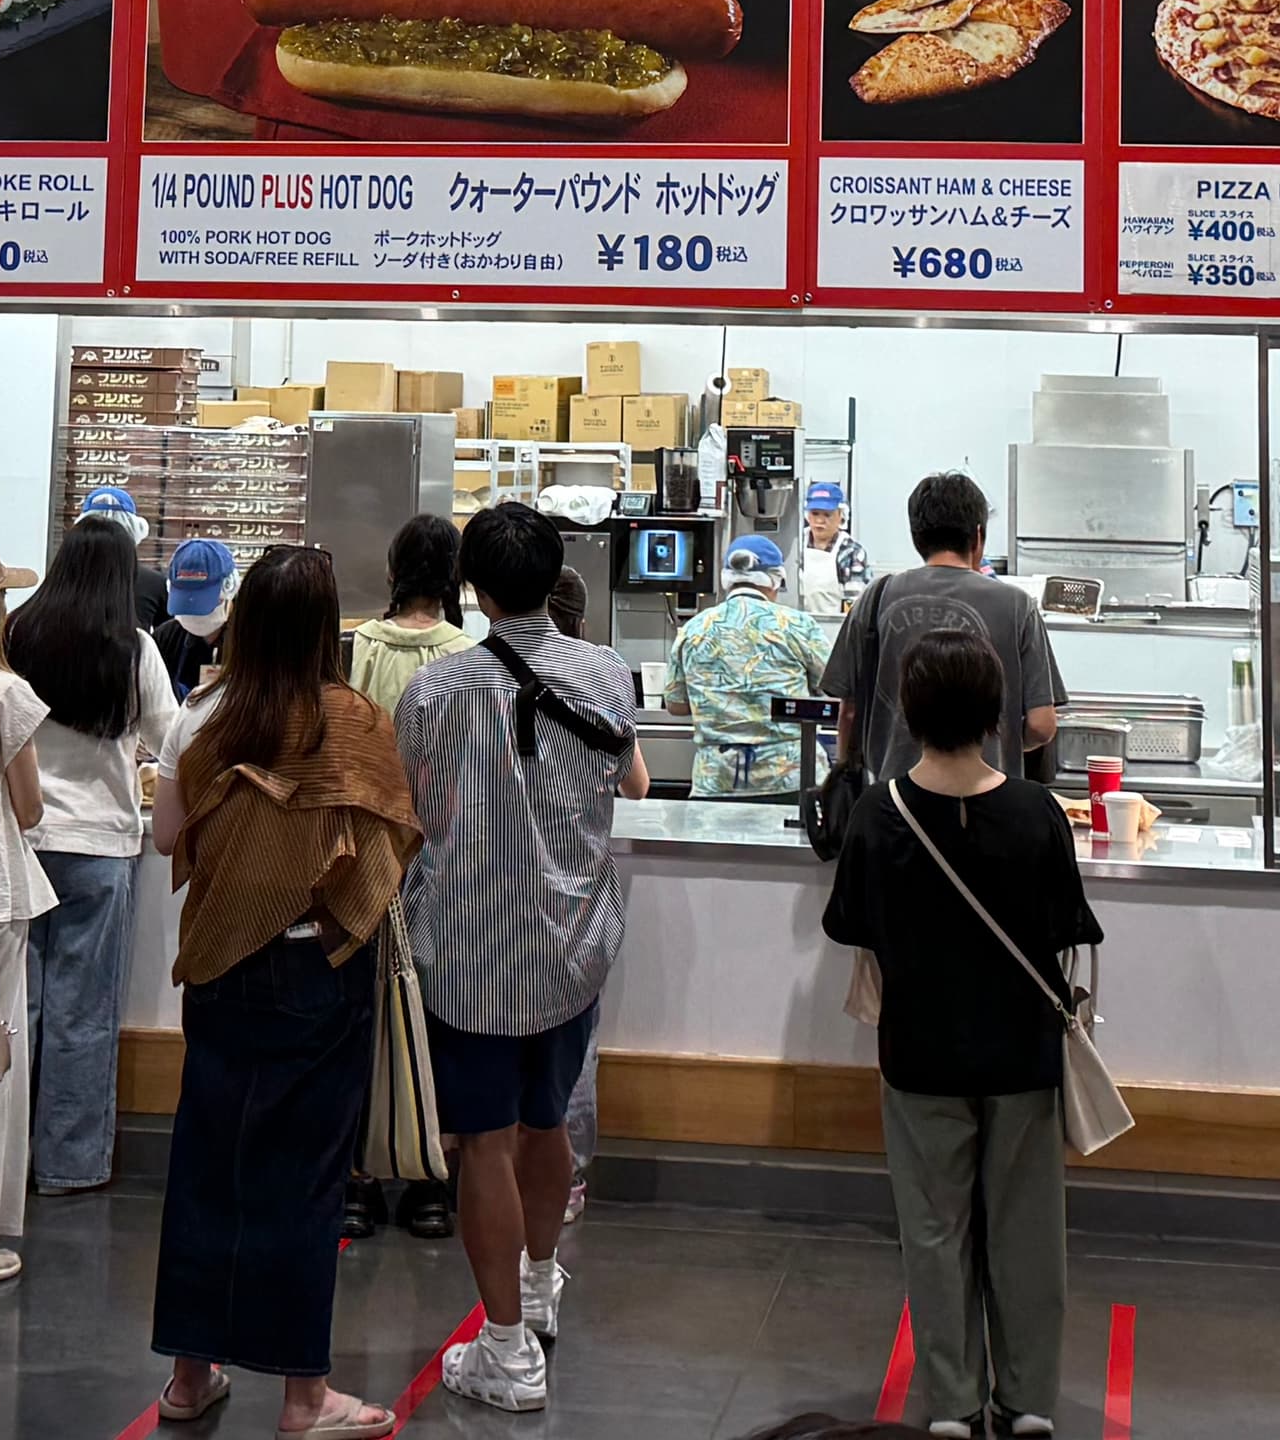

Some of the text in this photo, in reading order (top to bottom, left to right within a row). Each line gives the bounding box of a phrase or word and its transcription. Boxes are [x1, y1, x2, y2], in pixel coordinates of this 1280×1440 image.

[39, 175, 94, 191] ROLL
[830, 176, 1071, 196] CROISSANT HAM & CHEESE
[152, 173, 412, 209] 1/4 POUND PLUS HOT DOG
[449, 172, 779, 216] クォーターパウンド ホットドッグ
[1198, 181, 1270, 200] PIZZA
[831, 203, 1071, 228] クロワッサンハム&チーズ
[1124, 216, 1174, 224] HAWAIIAN
[1188, 210, 1215, 218] SLICE
[1122, 225, 1174, 235] ハワイアン
[161, 230, 331, 245] 100% PORK HOT DOG
[375, 230, 502, 248] ポークホットドッグ
[159, 251, 359, 266] WITH SODA/FREE REFILL
[374, 252, 562, 270] ソーダ付き(おかわり自由)
[1120, 260, 1174, 269] PEPPERONI
[1220, 255, 1253, 263] スライス
[102, 349, 153, 360] フジパン
[98, 373, 149, 384] フジパン
[93, 392, 144, 403] フジパン
[96, 413, 147, 424] フジパン
[73, 429, 127, 441] フジパン
[75, 450, 131, 461] フジパン
[236, 457, 290, 469] フジパン
[74, 473, 129, 484] フジパン
[234, 480, 290, 491] フジパン
[228, 523, 284, 536] フジパン
[888, 607, 976, 634] LIBERT
